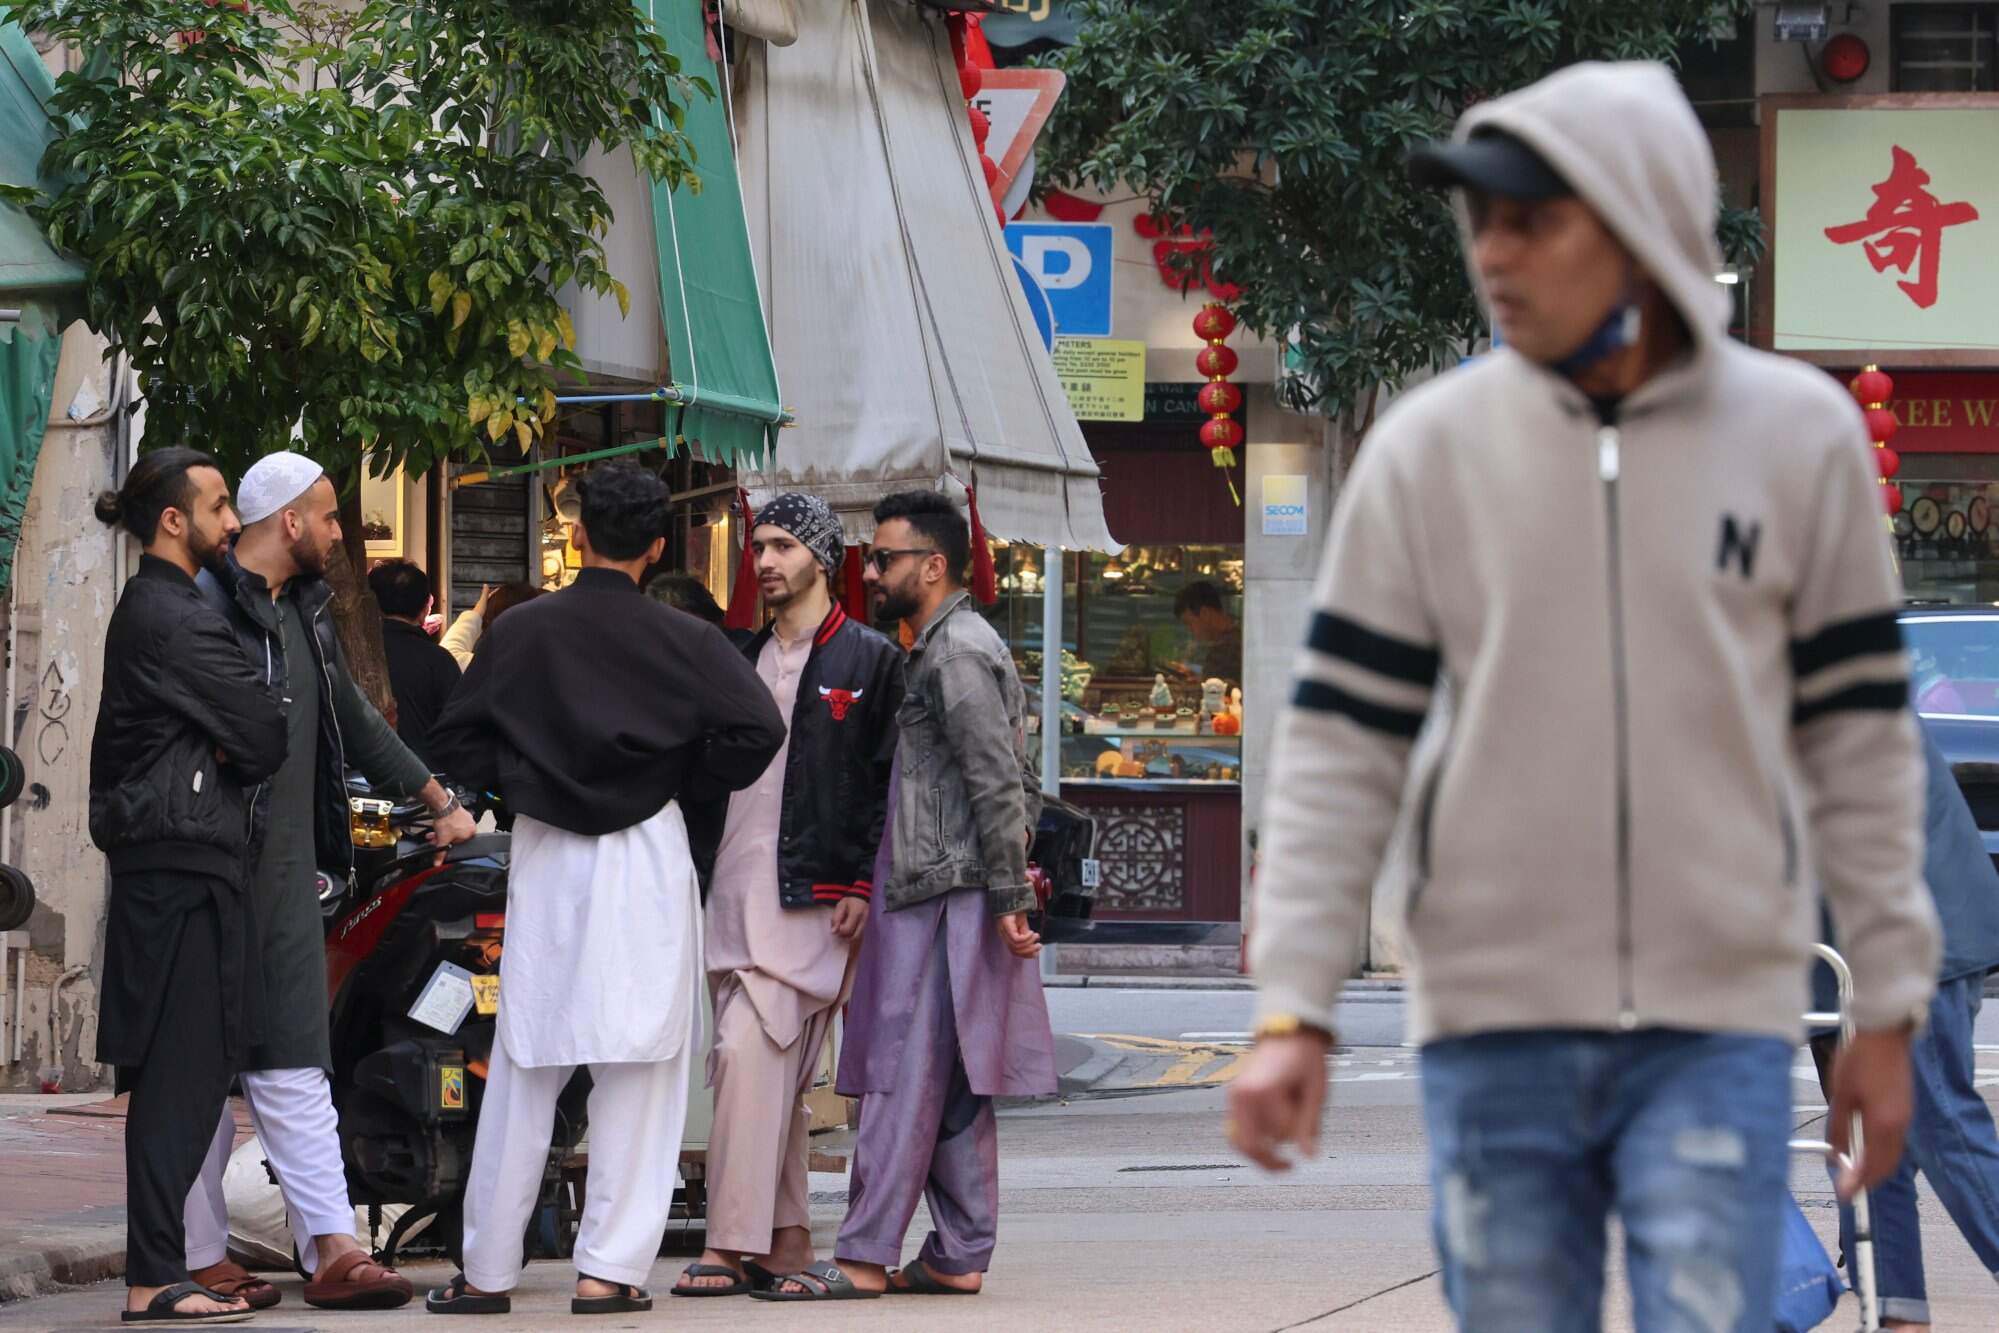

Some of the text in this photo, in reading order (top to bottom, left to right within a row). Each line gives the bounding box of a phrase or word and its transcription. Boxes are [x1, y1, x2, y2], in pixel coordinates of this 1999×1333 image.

[1824, 144, 1979, 310] 奇
[1022, 235, 1092, 289] P
[1164, 400, 1199, 413] CAN
[1962, 400, 1999, 427] W
[1717, 512, 1763, 578] N
